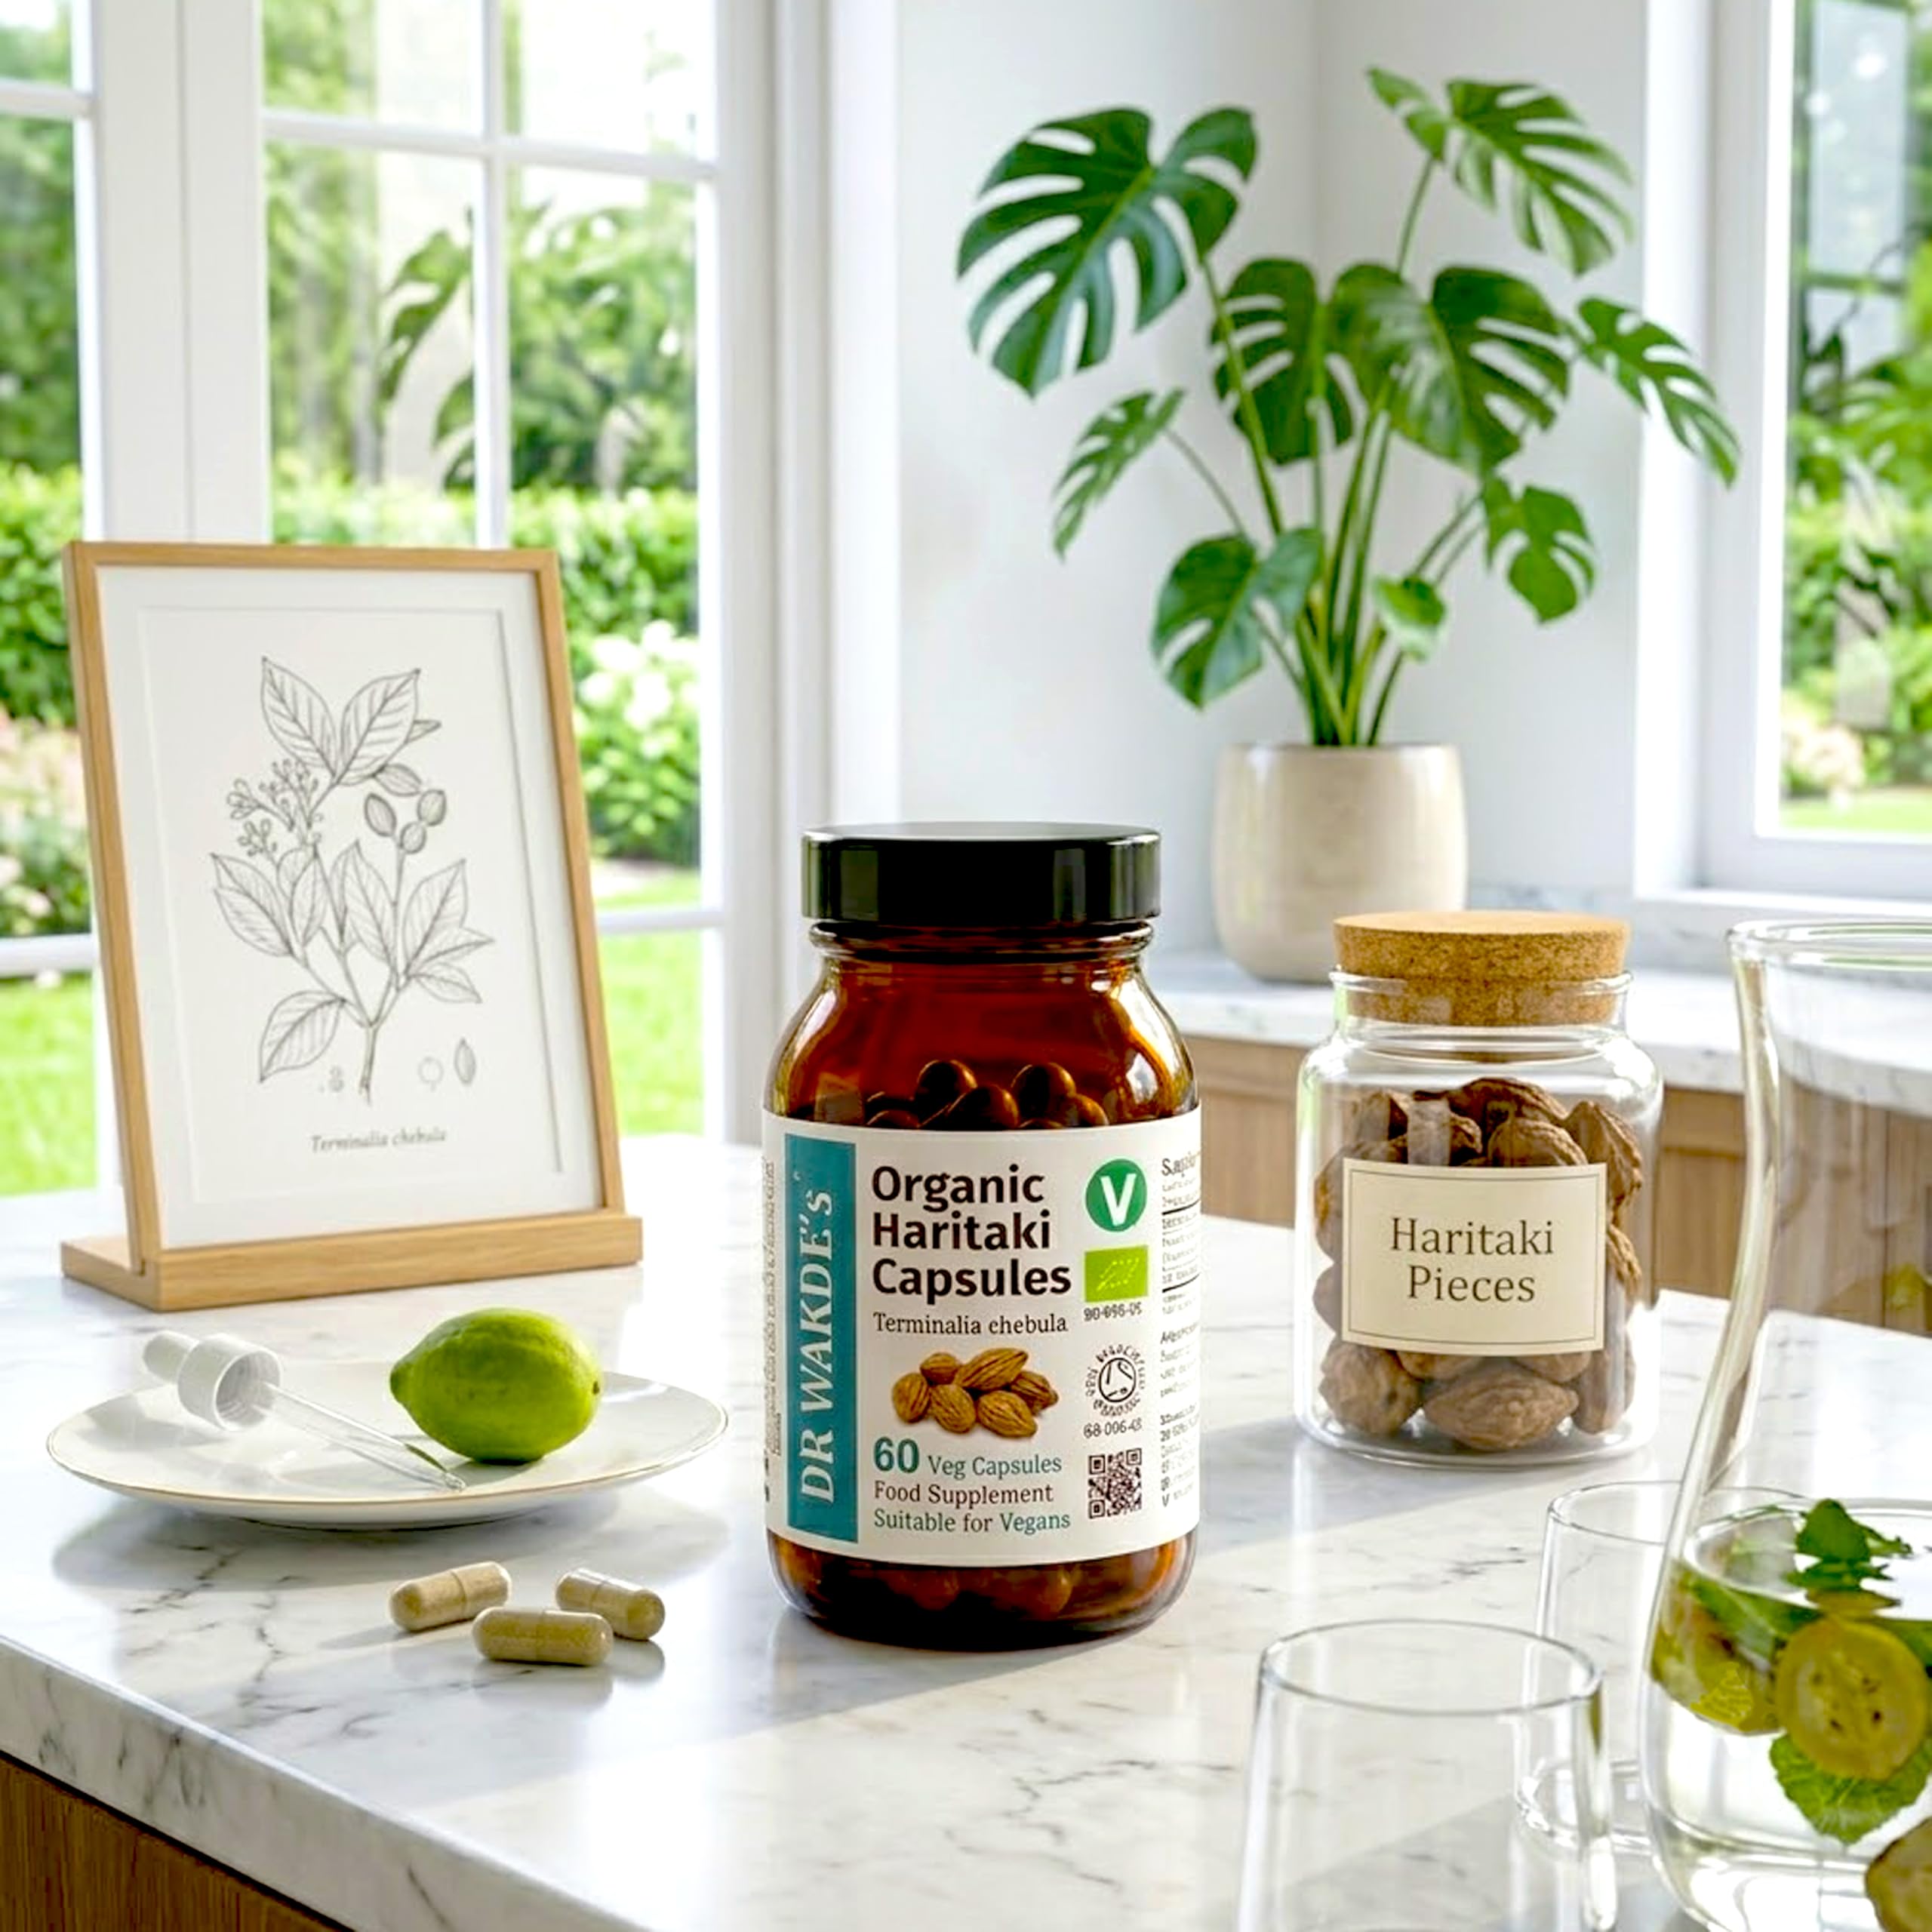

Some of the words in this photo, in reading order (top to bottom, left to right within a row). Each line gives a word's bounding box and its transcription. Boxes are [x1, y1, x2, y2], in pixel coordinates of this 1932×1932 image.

[872, 1164, 1045, 1212] Organic
[873, 1210, 1051, 1250] Haritaki
[1391, 1217, 1554, 1256] Haritaki
[873, 1258, 1072, 1305] Capsules
[1407, 1264, 1536, 1303] Pieces
[873, 1312, 981, 1335] Terminalia
[989, 1313, 1068, 1334] chebula
[800, 1429, 835, 1504] DR
[874, 1438, 918, 1473] 60
[928, 1456, 966, 1477] Veg
[972, 1454, 1063, 1476] Capsules
[875, 1483, 922, 1503] Food
[928, 1484, 1054, 1507] Supplement
[874, 1510, 956, 1534] Suitable
[963, 1512, 993, 1534] for
[1000, 1512, 1071, 1535] Vegans
